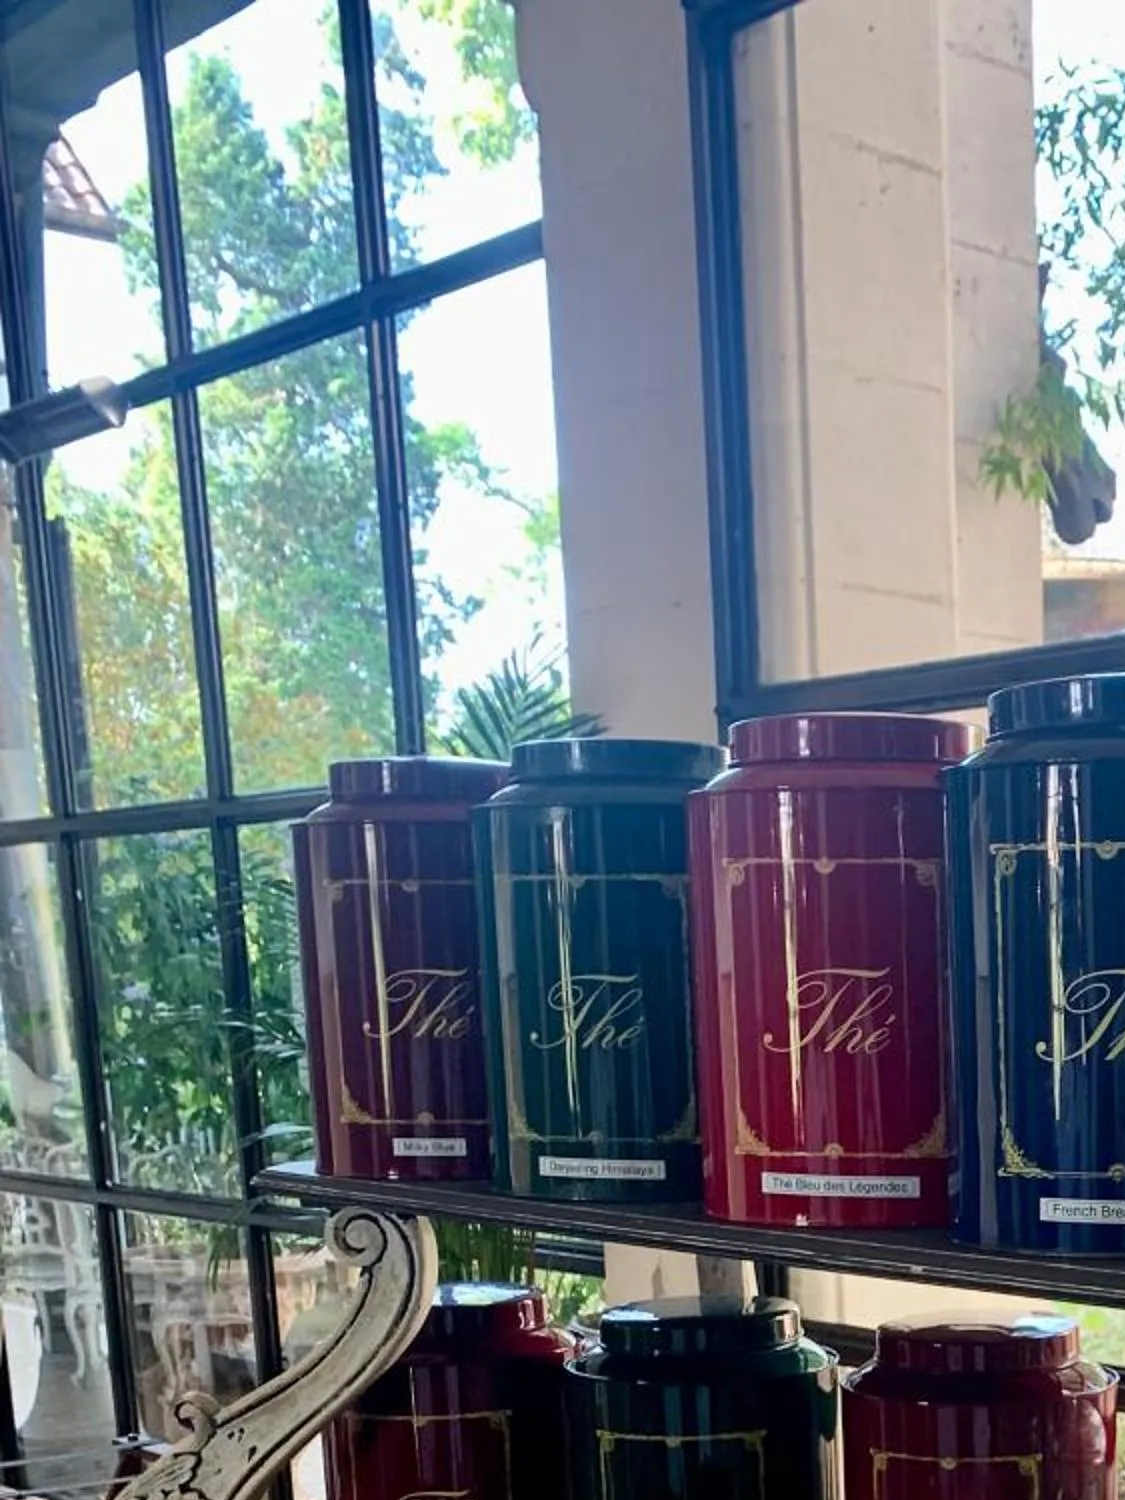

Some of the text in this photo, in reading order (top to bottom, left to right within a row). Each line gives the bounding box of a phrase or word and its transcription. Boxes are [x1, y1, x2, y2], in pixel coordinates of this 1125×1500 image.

[363, 967, 475, 1039] Thé
[530, 973, 645, 1050] Thé
[763, 966, 898, 1055] Thé
[1052, 1203, 1097, 1218] French
